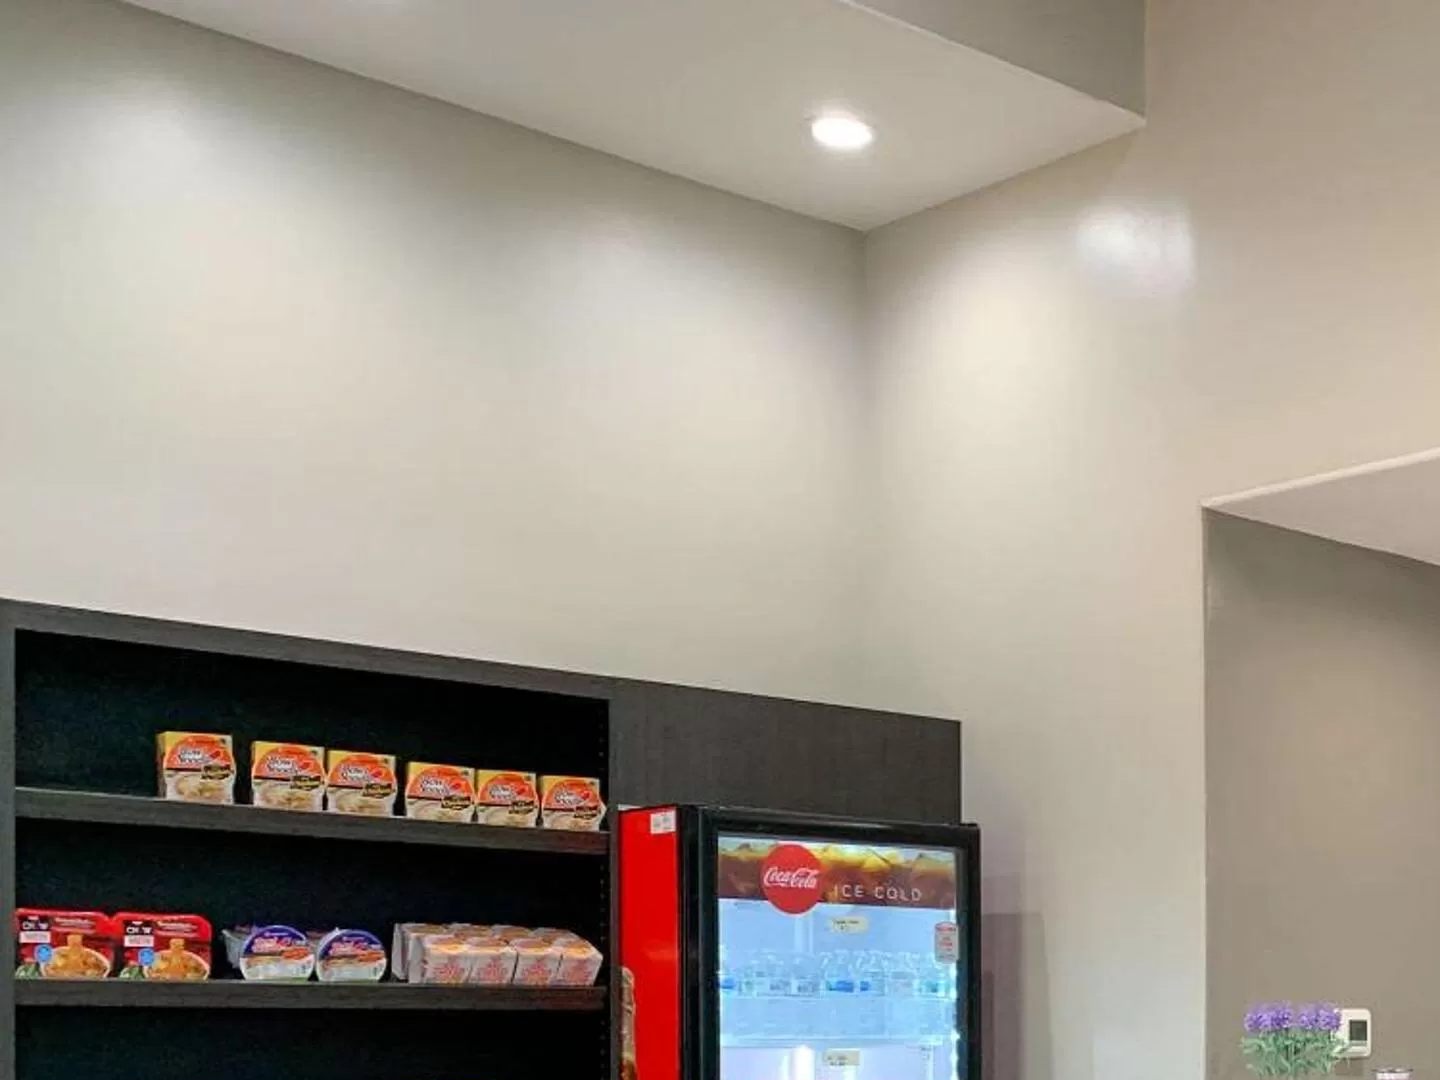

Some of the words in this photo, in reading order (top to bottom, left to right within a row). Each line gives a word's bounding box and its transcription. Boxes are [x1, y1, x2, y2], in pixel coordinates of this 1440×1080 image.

[763, 866, 820, 888] Coca-Cola
[833, 885, 864, 898] ICE
[875, 887, 922, 901] COLD
